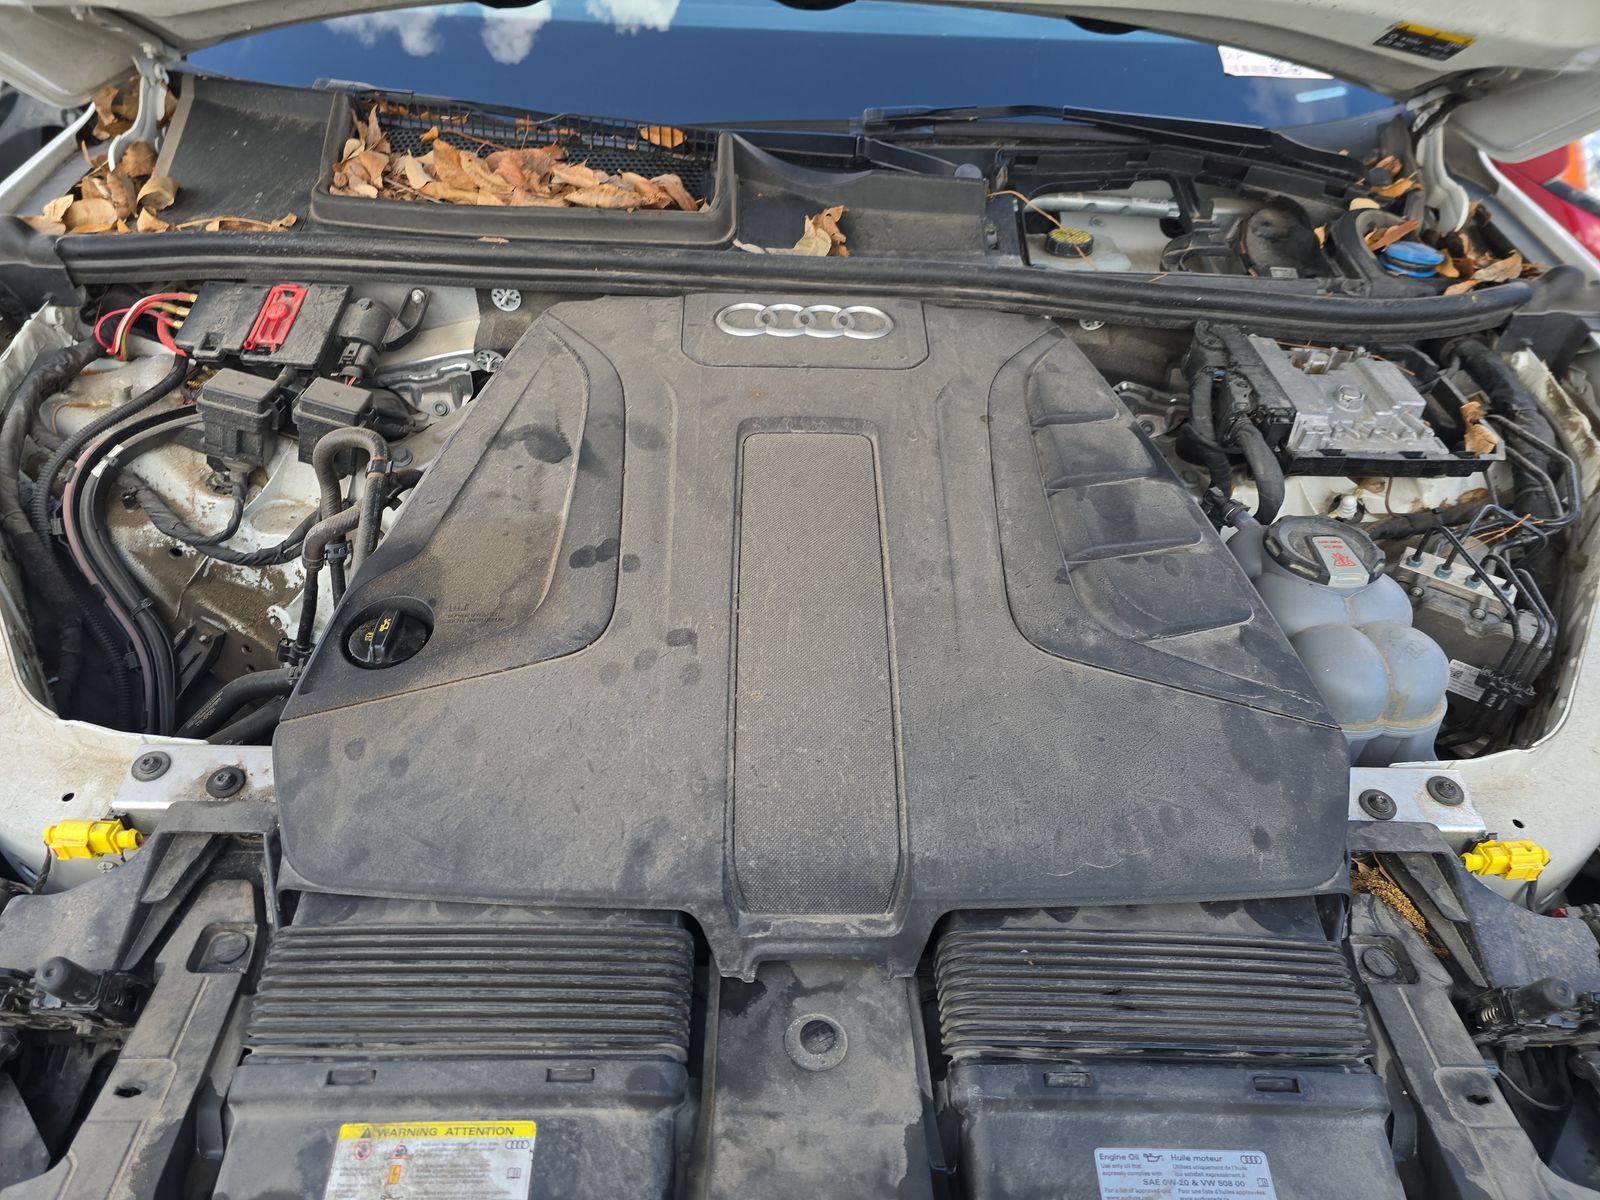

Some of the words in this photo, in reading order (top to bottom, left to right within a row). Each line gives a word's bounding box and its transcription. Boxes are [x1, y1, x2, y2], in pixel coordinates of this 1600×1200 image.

[376, 1127, 438, 1137] WARNING
[444, 1126, 515, 1136] ATTENTION
[1099, 1153, 1127, 1162] Engine
[1128, 1153, 1140, 1161] Oil
